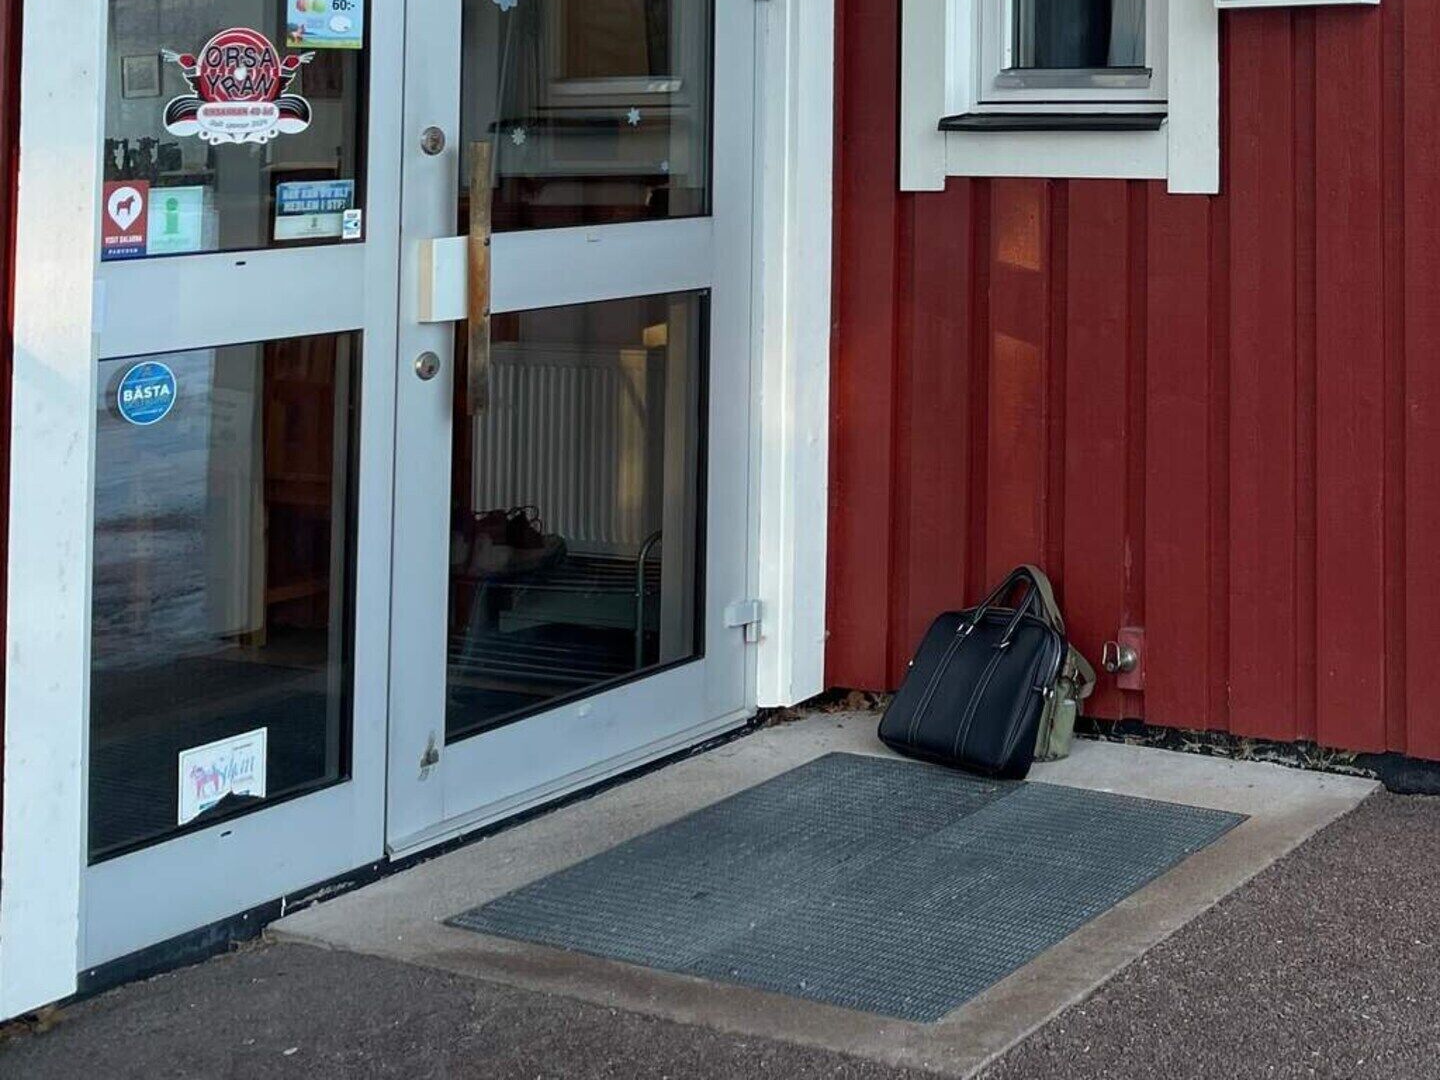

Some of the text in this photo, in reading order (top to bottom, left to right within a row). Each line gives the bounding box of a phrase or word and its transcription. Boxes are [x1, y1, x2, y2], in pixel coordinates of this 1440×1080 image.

[206, 46, 274, 68] ORSA
[206, 73, 275, 98] YRAN
[105, 236, 119, 244] VISIT
[123, 383, 170, 402] BÄSTA
